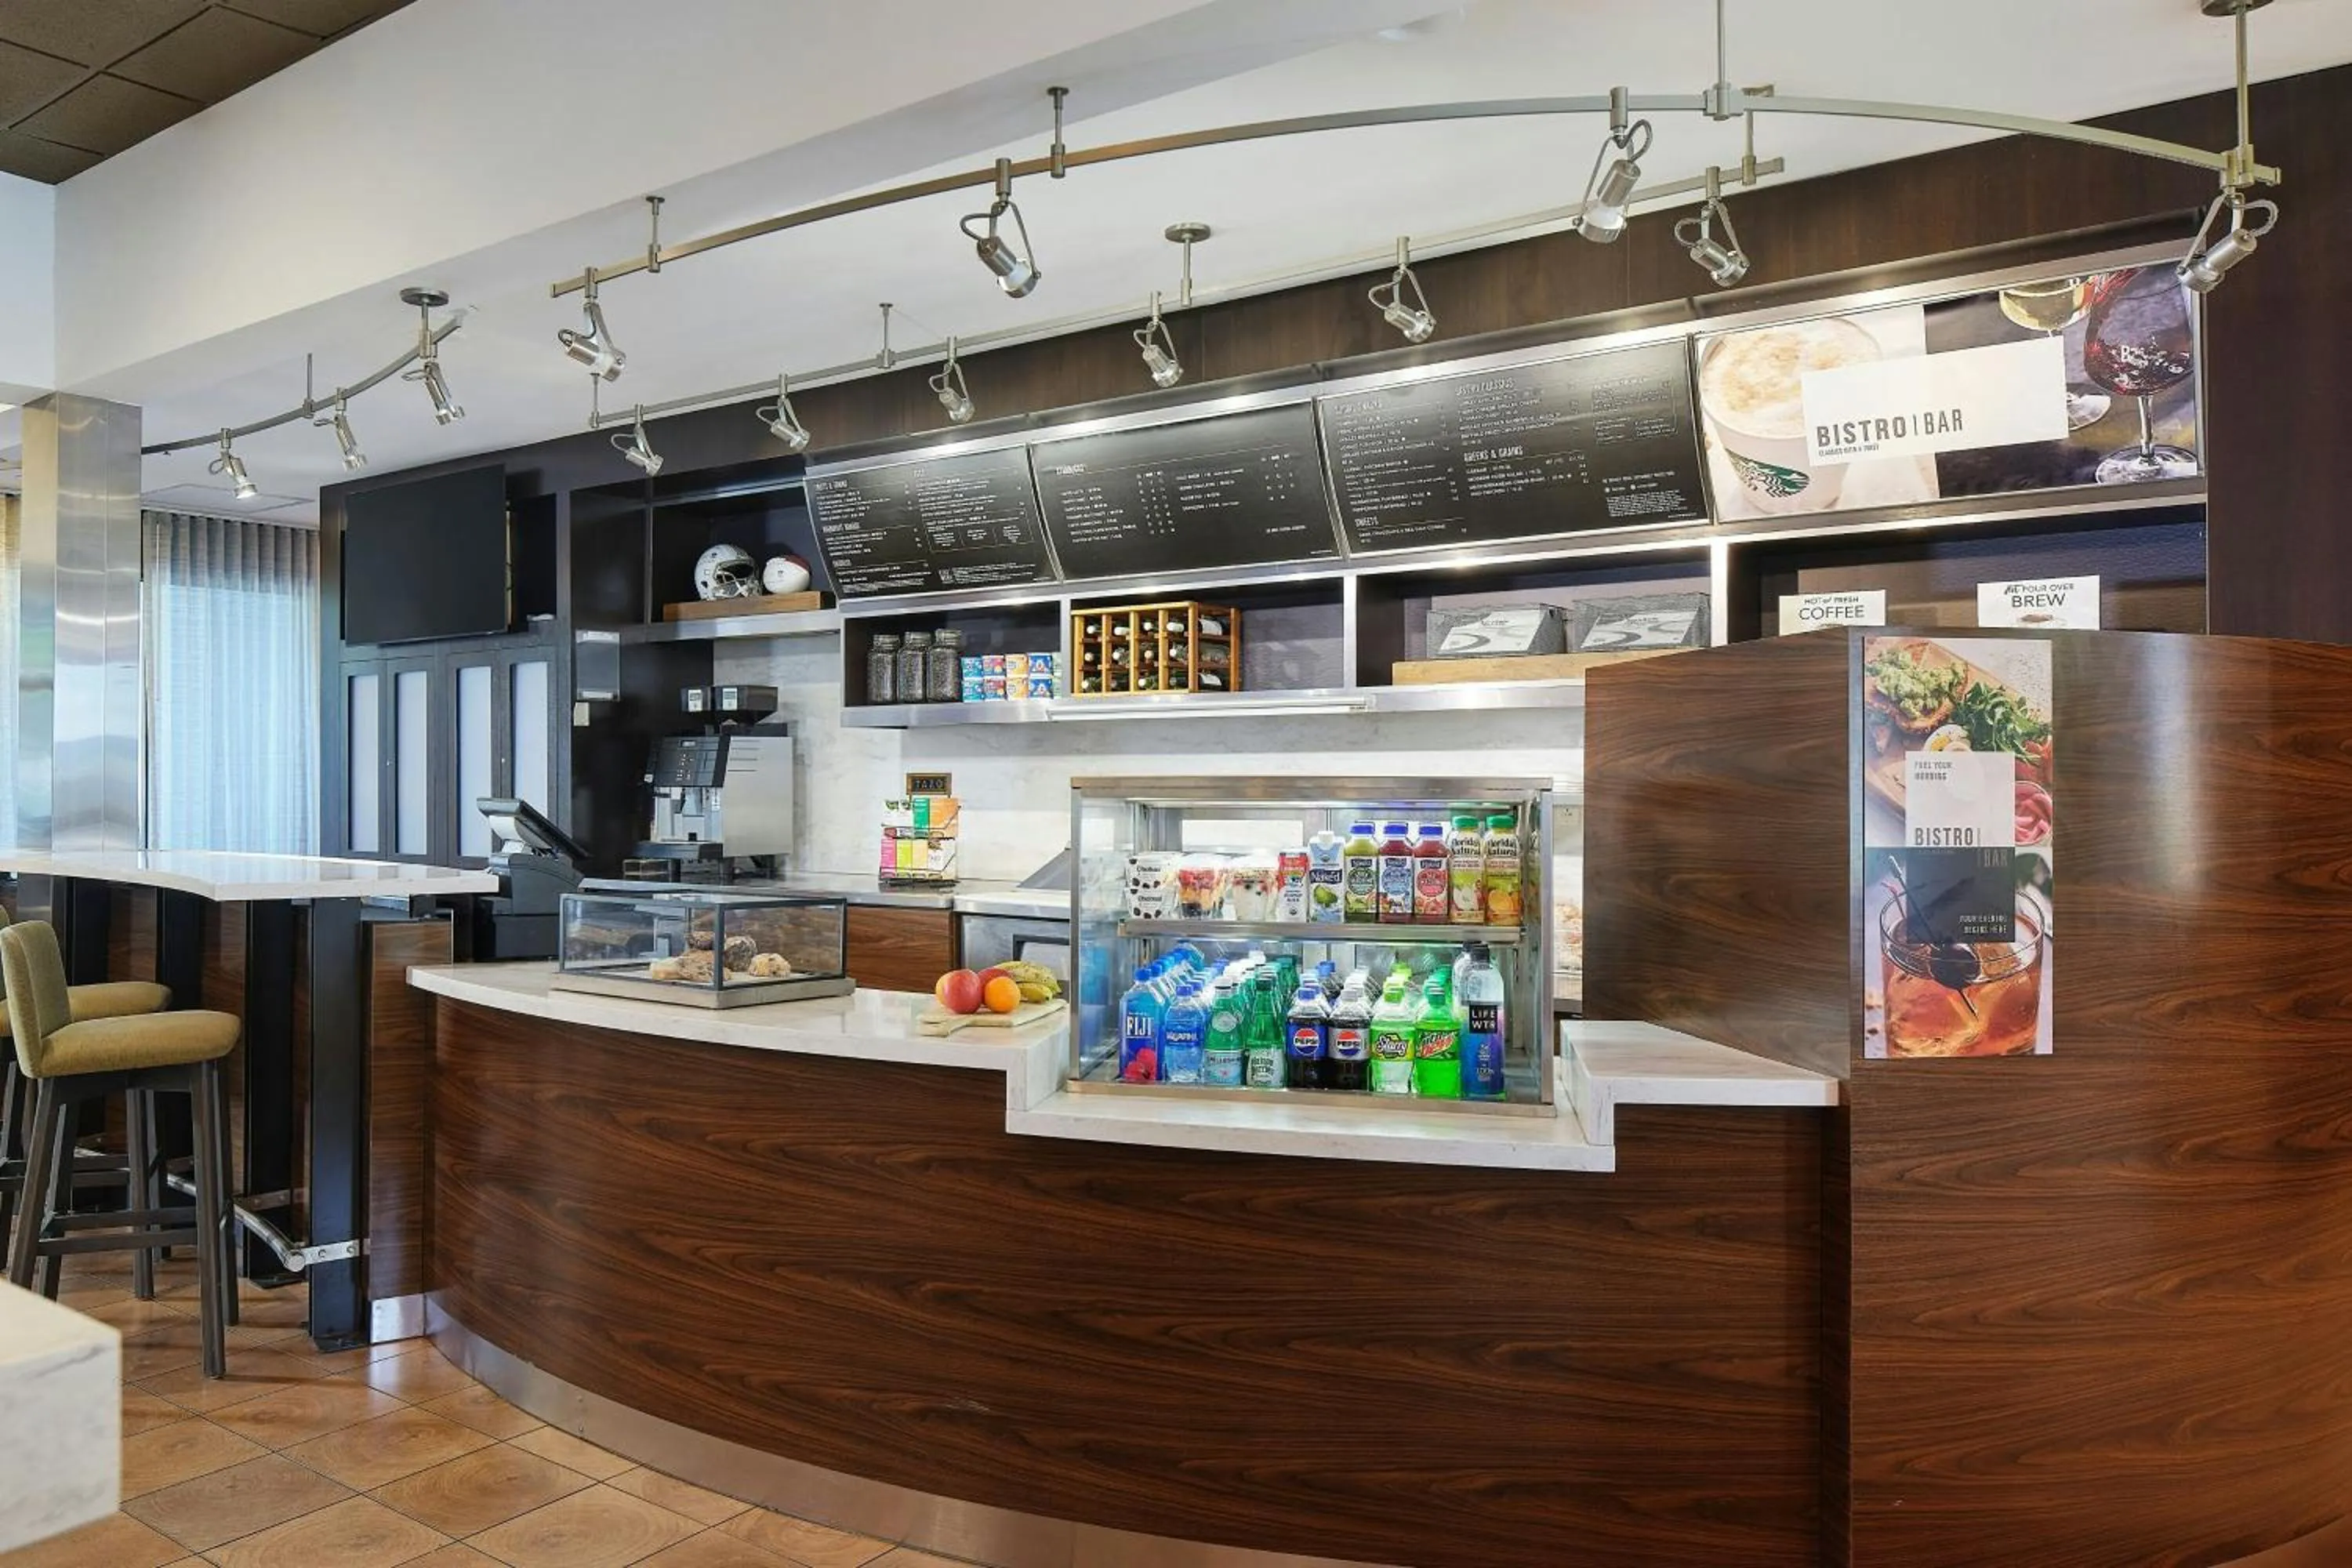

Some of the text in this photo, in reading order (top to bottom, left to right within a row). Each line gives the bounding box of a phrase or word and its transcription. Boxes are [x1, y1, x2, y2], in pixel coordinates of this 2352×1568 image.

[1817, 408, 1962, 448] BISTRO BAR
[2012, 593, 2065, 608] BREW
[1798, 605, 1864, 620] COFFEE
[1915, 827, 1973, 846] BISTRO
[1984, 848, 2008, 867] BAR
[1472, 1009, 1495, 1018] LIFE
[1127, 1016, 1152, 1036] FIJI
[1472, 1021, 1496, 1029] WTR
